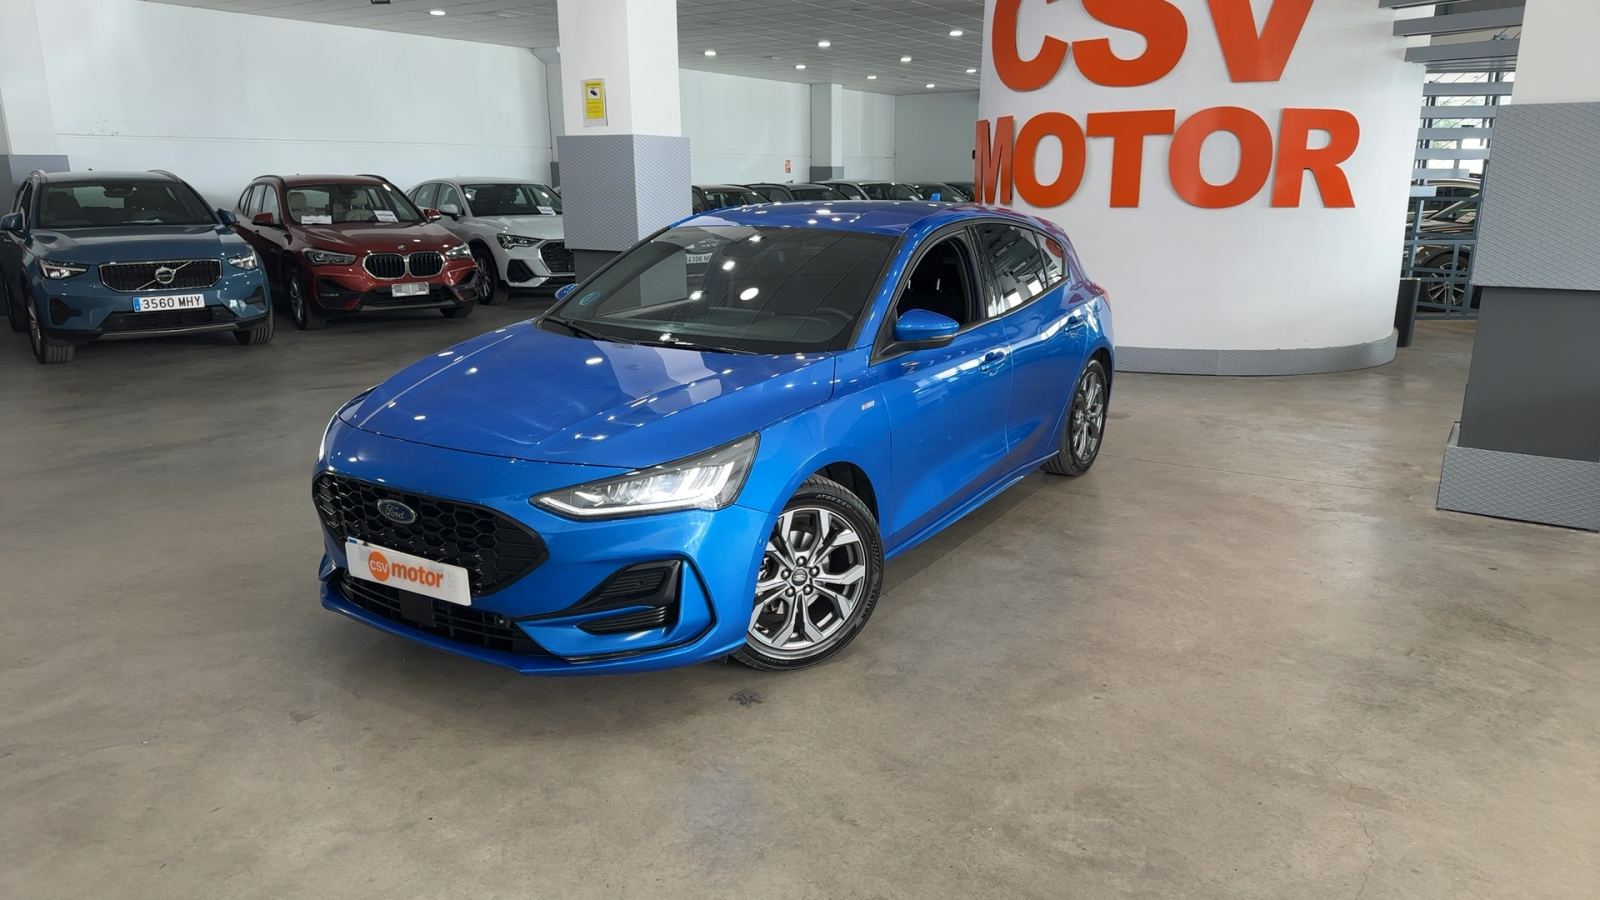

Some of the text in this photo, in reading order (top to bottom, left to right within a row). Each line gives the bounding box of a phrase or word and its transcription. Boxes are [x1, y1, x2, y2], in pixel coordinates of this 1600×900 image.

[992, 0, 1315, 92] CSV
[974, 106, 1360, 209] MOTOR
[142, 295, 201, 310] 3560 MHY
[384, 503, 406, 520] Ford
[391, 562, 444, 588] motor
